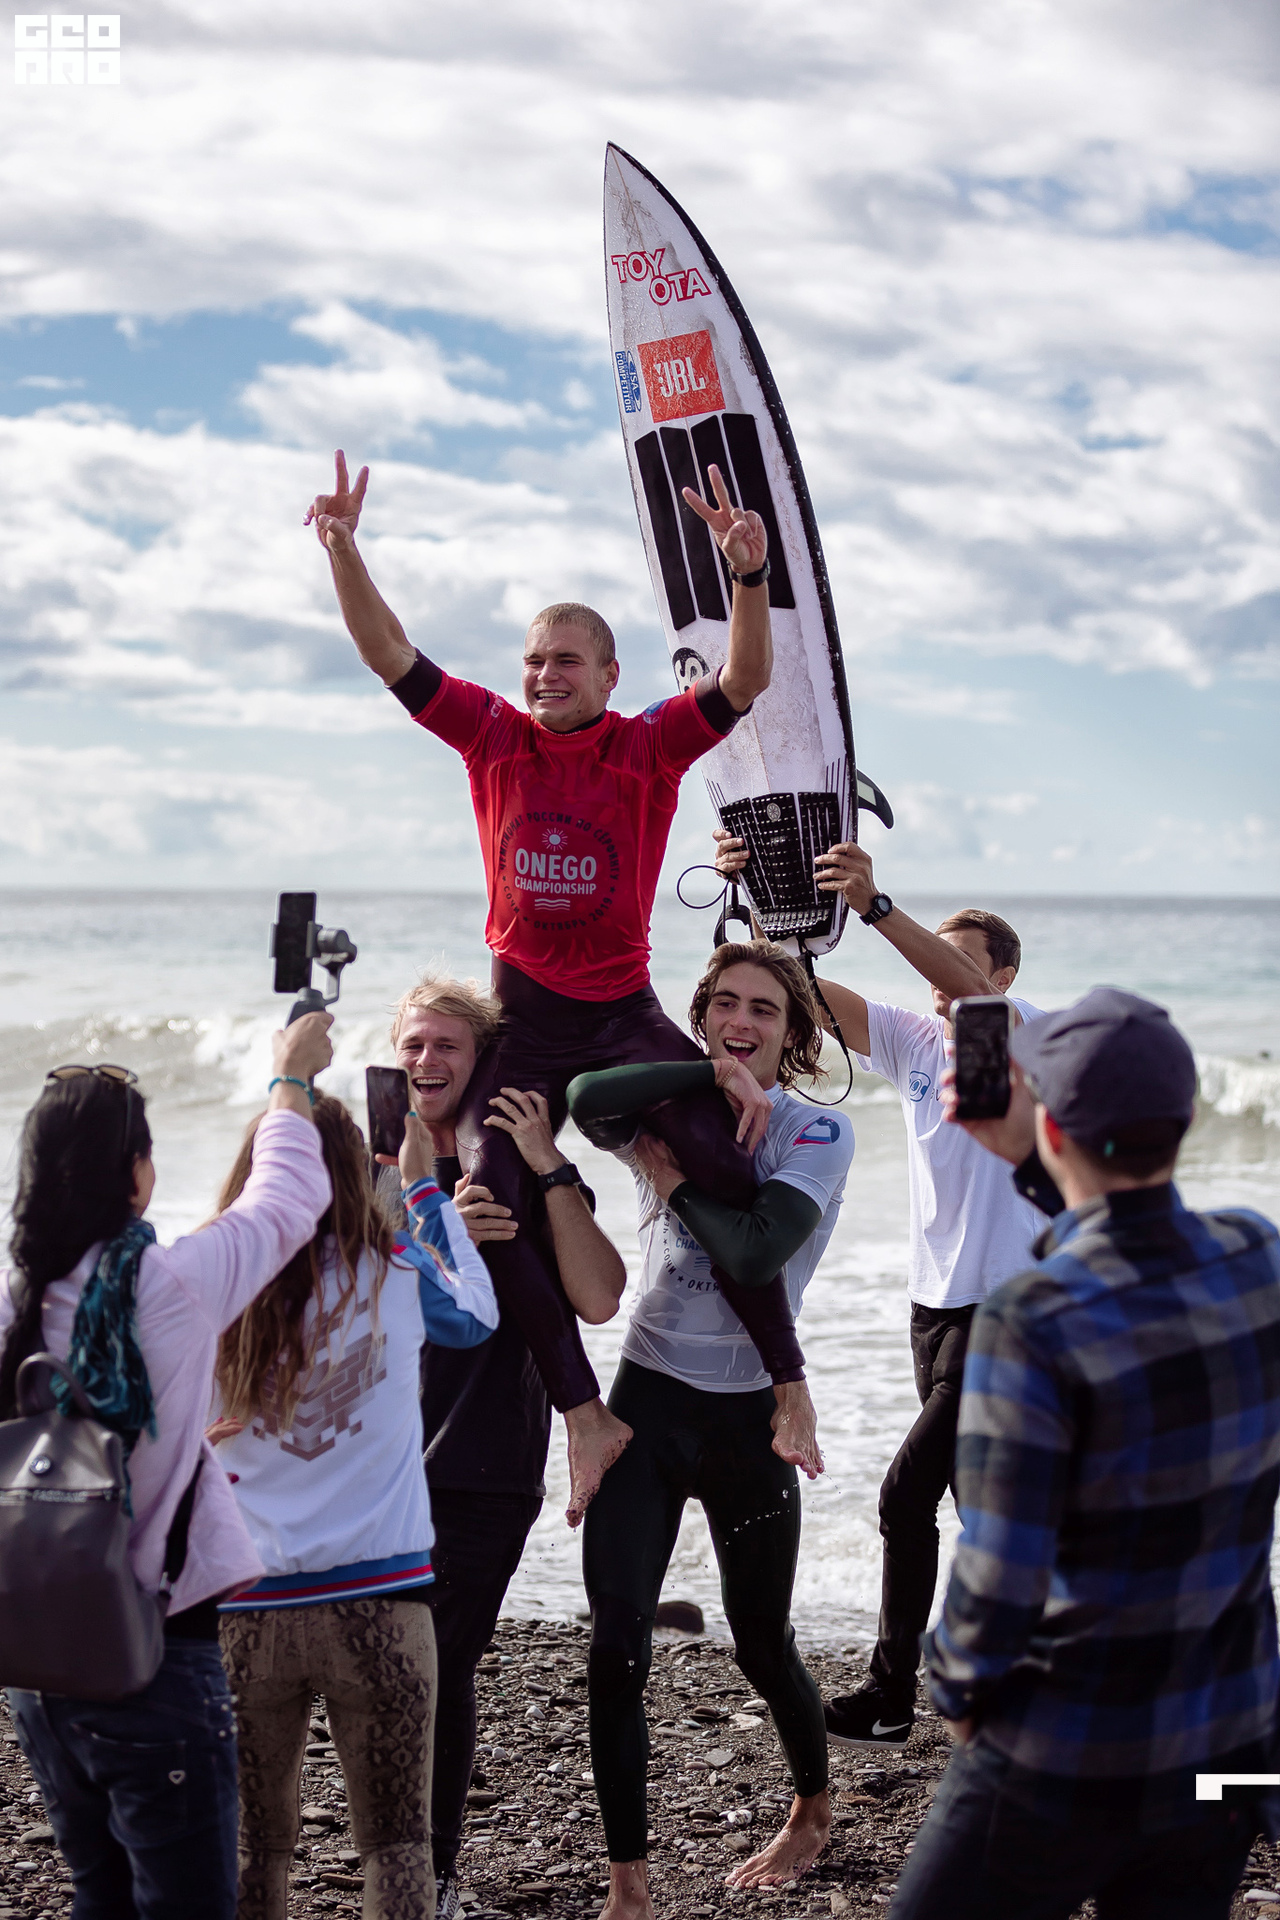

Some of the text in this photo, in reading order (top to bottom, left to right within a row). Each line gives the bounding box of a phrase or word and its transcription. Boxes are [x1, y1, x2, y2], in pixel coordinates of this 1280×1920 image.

[616, 353, 632, 412] COMPETITOR
[630, 372, 639, 390] ISA
[655, 356, 706, 398] JBL
[500, 815, 524, 870] ЧЕМПИОНАТ
[527, 811, 572, 824] РОССИИ
[576, 818, 592, 832] ПО
[515, 848, 597, 881] ONEGO
[503, 885, 520, 914] СОЧИ
[514, 875, 597, 895] CHAMPIONSHIP
[534, 897, 613, 930] ОКТЯБРЬ 2019
[663, 1248, 677, 1275] СОЧИ
[687, 1280, 720, 1291] ОКТЯ
